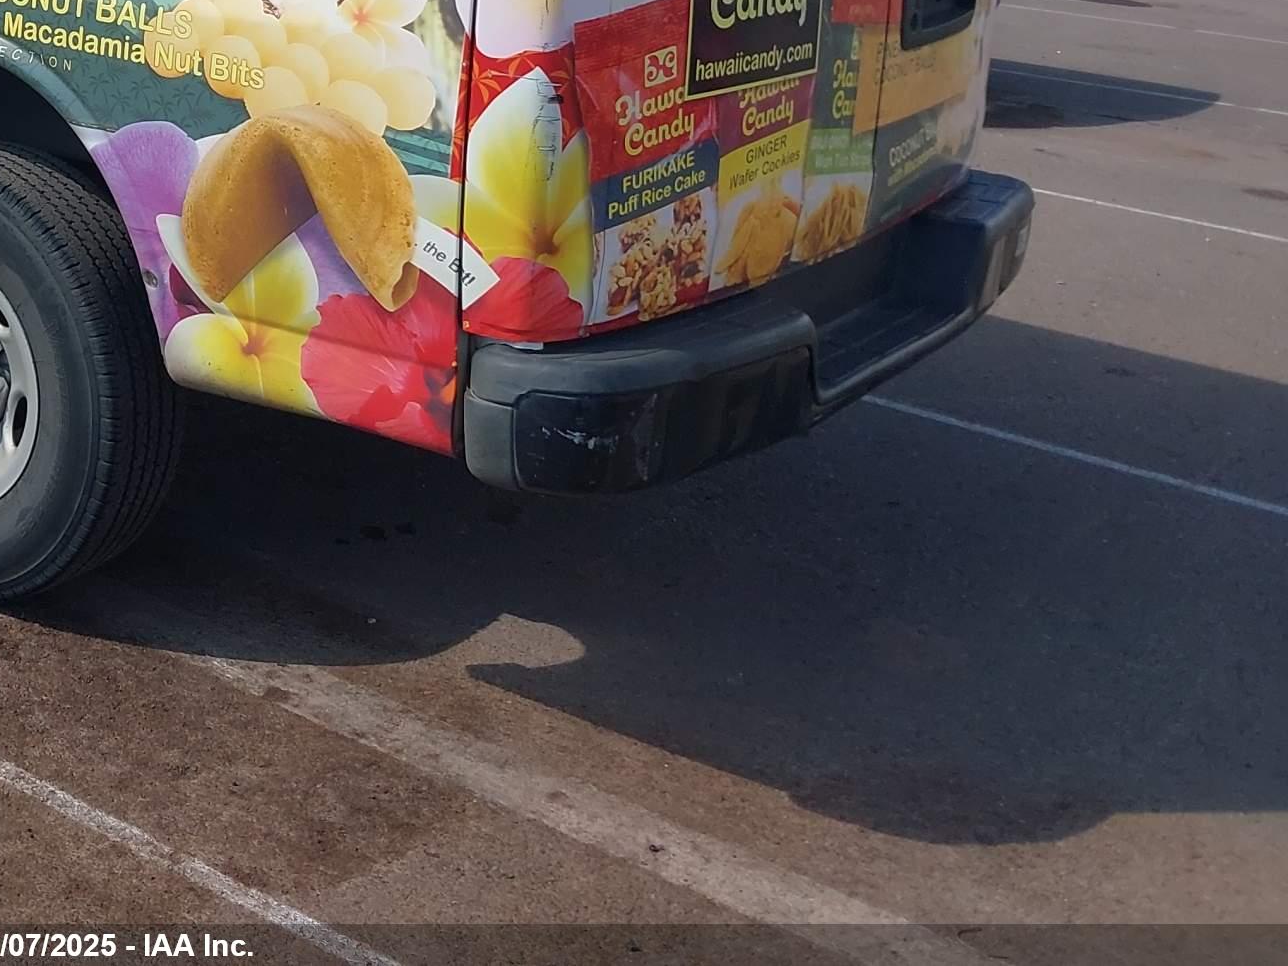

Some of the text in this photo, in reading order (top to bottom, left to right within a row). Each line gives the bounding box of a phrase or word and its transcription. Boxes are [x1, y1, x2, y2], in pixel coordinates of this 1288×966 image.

[3, 11, 146, 65] Macadamia
[154, 40, 203, 76] Nut
[210, 52, 265, 90] Bits
[695, 42, 813, 81] hawaiicandy.com
[624, 108, 695, 156] Candy
[742, 95, 794, 137] Candy
[729, 166, 759, 190] Wafer
[761, 150, 801, 175] Cookies
[746, 134, 788, 164] GINGER
[623, 150, 696, 193] FURIKAKE
[608, 169, 706, 220] Puff Rice Cake
[423, 241, 476, 287] the Bt!
